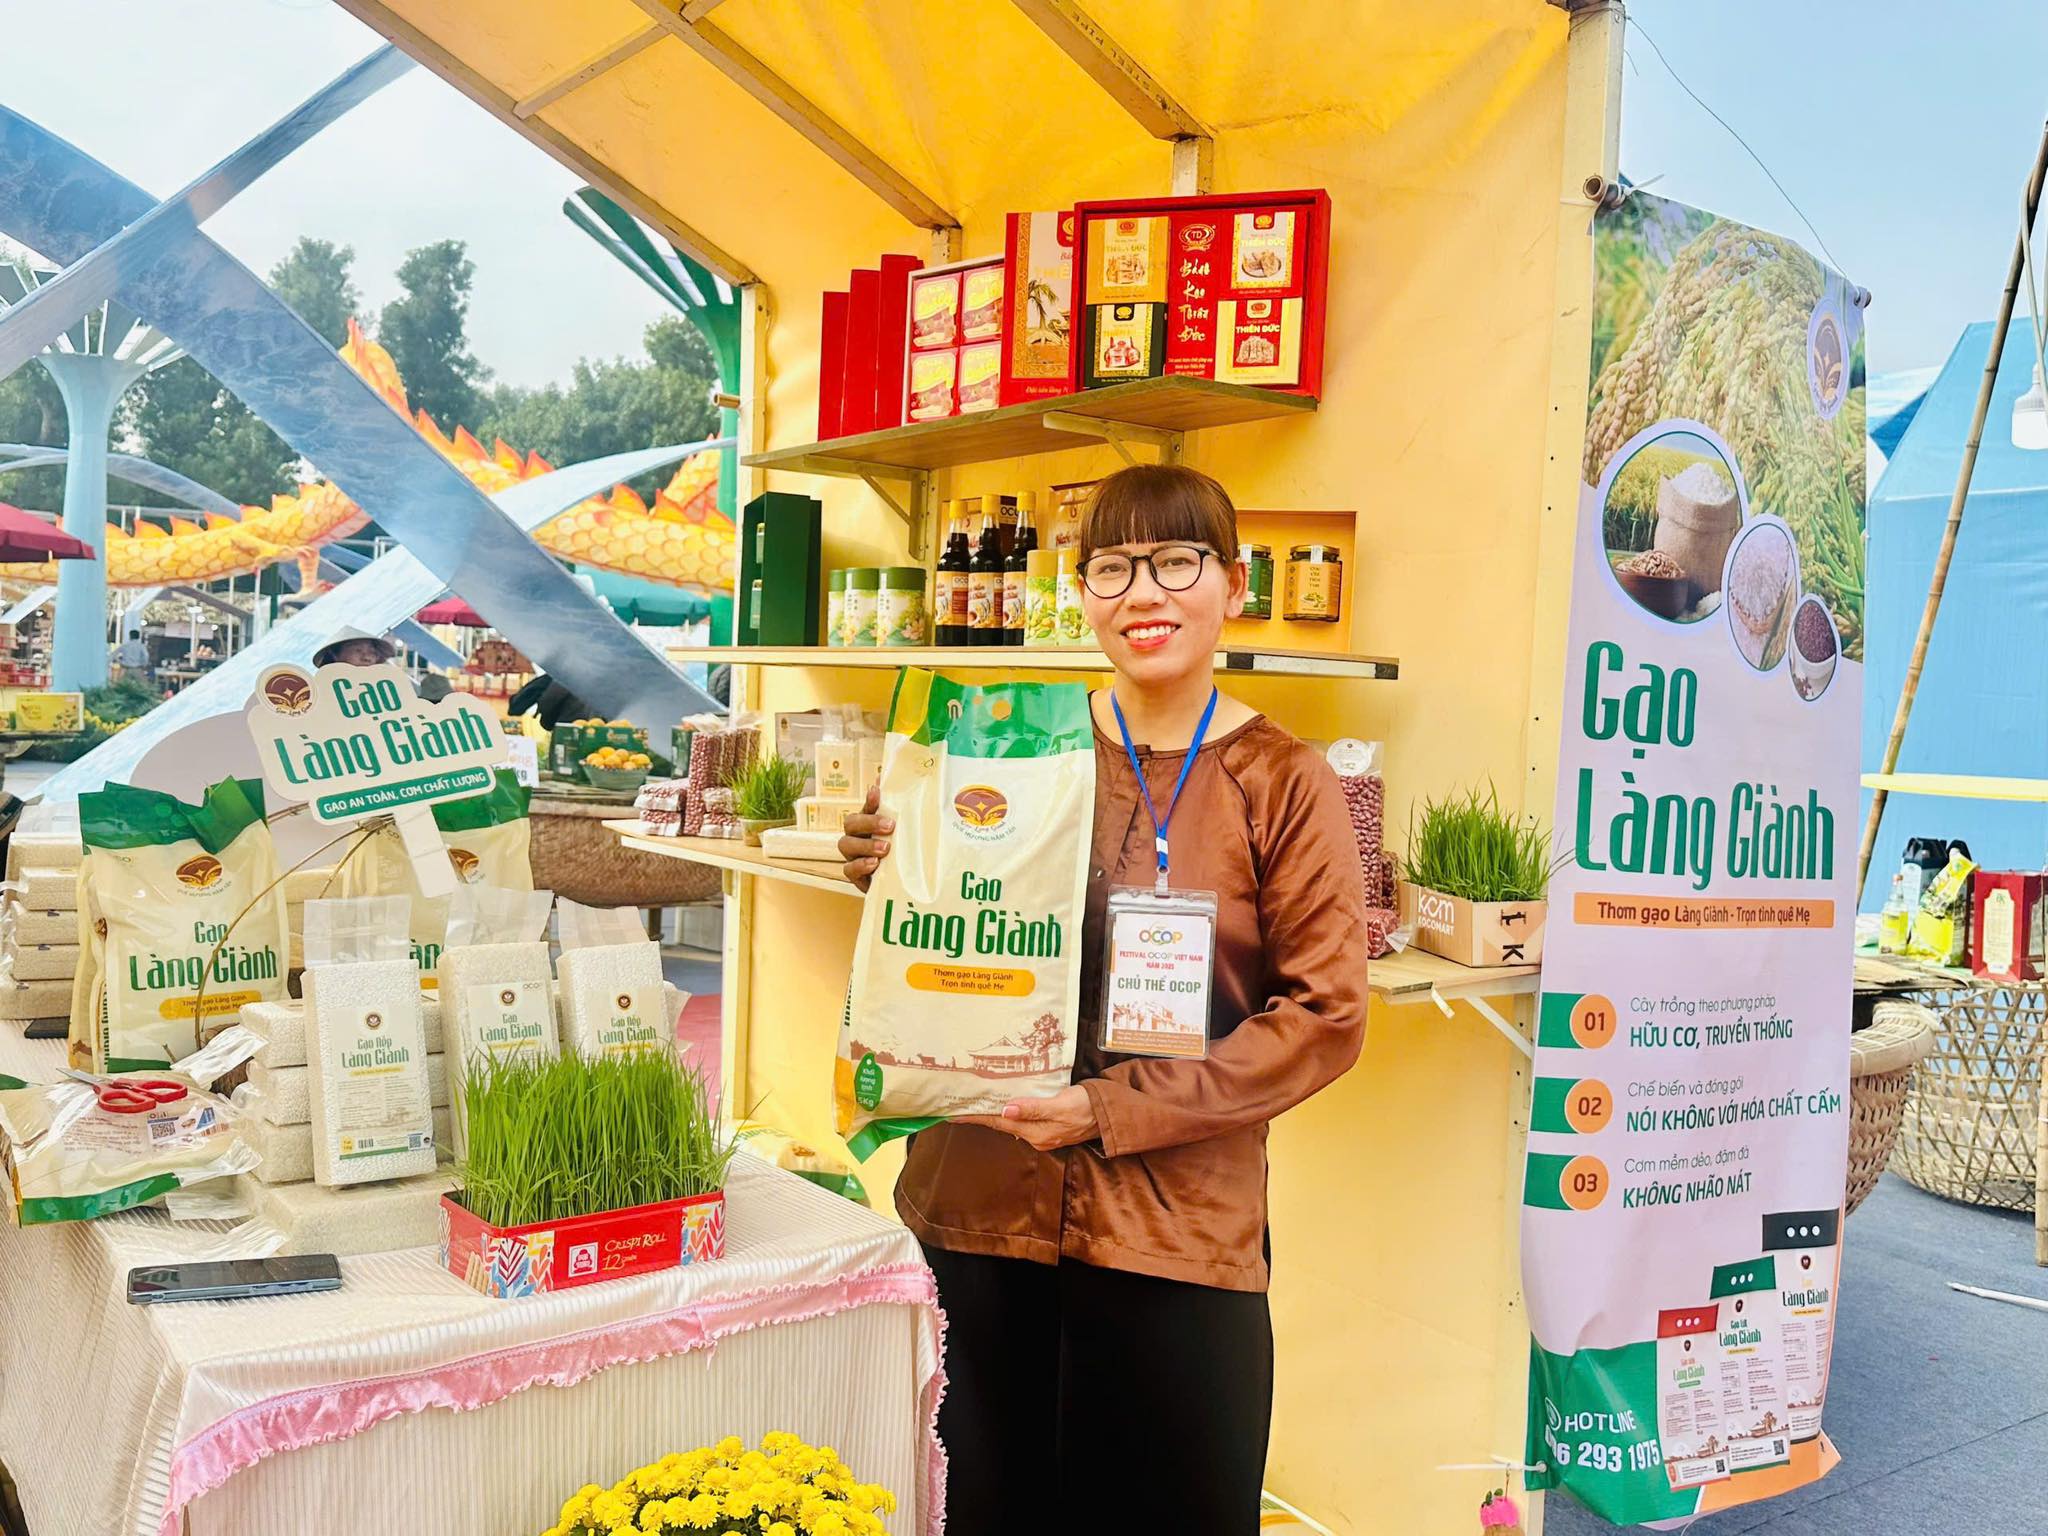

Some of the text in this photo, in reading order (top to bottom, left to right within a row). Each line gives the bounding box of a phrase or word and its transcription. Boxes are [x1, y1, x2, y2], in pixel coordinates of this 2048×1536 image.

[332, 678, 402, 721] Gạo
[1583, 640, 1697, 759] Gạo
[274, 707, 493, 784] Làng Giành
[324, 772, 487, 815] GẠO AN TOÀN, CƠM CHẤT LƯỢNG
[1575, 768, 1834, 891] Làng Giành
[961, 871, 1002, 905] Gạo
[1597, 901, 1636, 920] Thơm
[1641, 905, 1670, 928] gạo
[1675, 904, 1702, 926] Làng
[1703, 905, 1729, 923] Giành
[1736, 906, 1757, 926] Trọn
[1758, 905, 1776, 923] tình
[1777, 904, 1795, 926] quê
[1796, 906, 1811, 927] Mẹ
[194, 920, 229, 946] Gạo
[882, 899, 1062, 958] Làng Giành
[1139, 930, 1183, 945] OCOP
[129, 945, 278, 991] Làng Giành
[933, 968, 955, 977] Thơm
[1117, 974, 1141, 990] CHỦ
[1169, 980, 1202, 993] OCOP
[1630, 994, 1776, 1017] Cây trồng theo phương pháp
[1584, 1011, 1606, 1031] 01
[1630, 1012, 1793, 1049] HỮU CƠ, TRUYỀN THỐNG
[342, 1051, 372, 1069] Làng
[1627, 1076, 1744, 1097] Chế biến và đóng gói
[1578, 1096, 1602, 1116] 02
[1626, 1087, 1841, 1133] NÓI KHÔNG VỚI HÓA CHẤT CẤM
[1624, 1157, 1656, 1173] Cơm
[1659, 1153, 1689, 1172] mềm
[1715, 1148, 1736, 1167] đậm
[1737, 1146, 1750, 1160] đà
[1573, 1173, 1598, 1193] 03
[1623, 1169, 1752, 1208] KHÔNG NHÃO NÁT
[642, 1233, 668, 1248] ROLL
[1782, 1291, 1805, 1307] Làng
[1720, 1331, 1737, 1347] Làng
[1565, 1410, 1637, 1433] HOTLINE
[1577, 1442, 1622, 1472] 293
[1628, 1439, 1660, 1471] 1975
